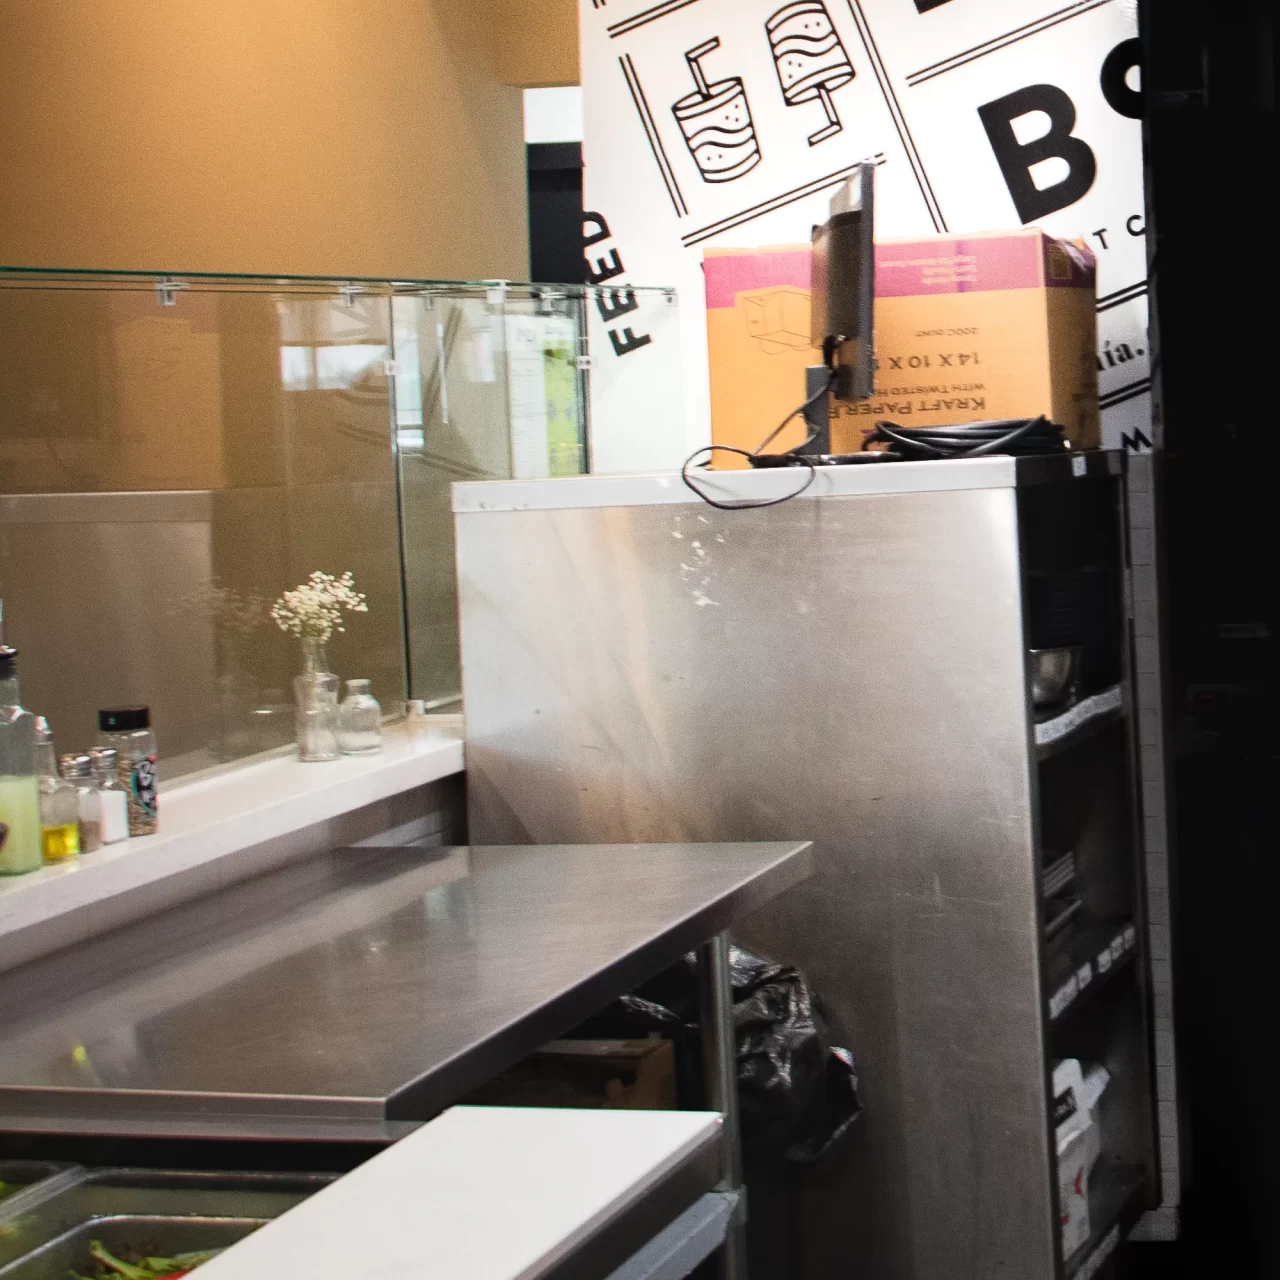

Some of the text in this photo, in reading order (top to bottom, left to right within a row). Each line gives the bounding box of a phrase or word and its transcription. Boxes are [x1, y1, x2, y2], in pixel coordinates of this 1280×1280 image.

[888, 357, 903, 370] X
[908, 355, 931, 369] 10
[939, 354, 953, 367] X
[958, 352, 980, 366] 14
[845, 401, 913, 416] PAPER
[918, 397, 987, 413] KRAFT
